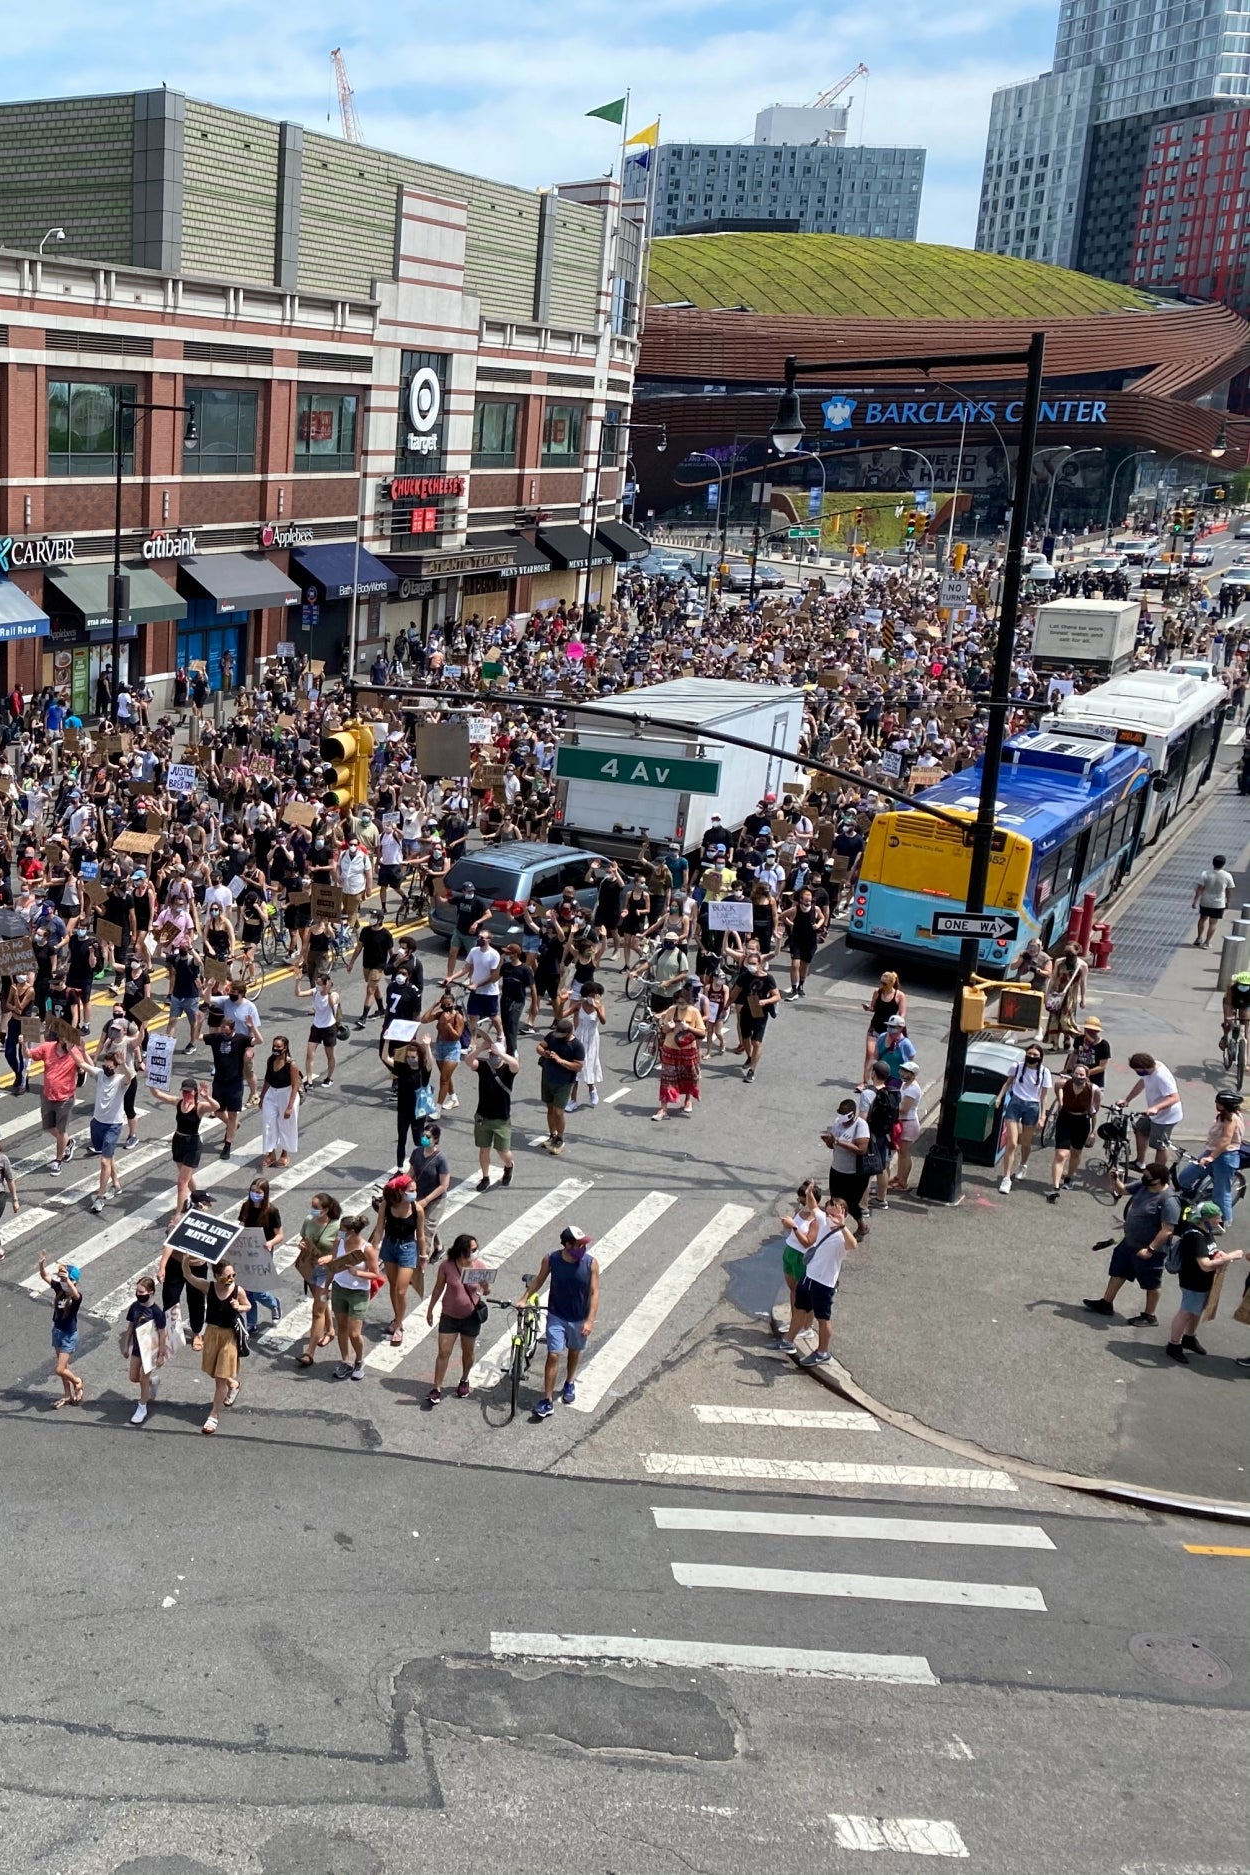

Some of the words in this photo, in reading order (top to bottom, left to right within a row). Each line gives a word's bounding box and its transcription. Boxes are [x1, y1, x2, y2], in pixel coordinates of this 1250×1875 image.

[865, 401, 996, 424] BARCLAYS
[1005, 401, 1108, 425] CNTER
[407, 432, 438, 455] target
[950, 454, 977, 466] GO
[919, 467, 976, 482] HARD
[391, 479, 421, 501] CHUCK
[428, 477, 466, 497] CHEESE'S
[11, 538, 77, 565] CARVER
[143, 531, 197, 559] citibank
[428, 558, 471, 573] ATLANTIC
[500, 568, 518, 577] MEN'S
[519, 562, 551, 576] WEARHOUSE
[568, 560, 584, 568] MEN'S
[339, 585, 353, 595] Bath
[410, 580, 433, 597] target
[947, 583, 962, 592] NO
[942, 594, 966, 602] TURNS
[17, 624, 37, 636] Road
[1094, 727, 1116, 737] 4599
[885, 752, 900, 763] NOW
[170, 766, 195, 777] JUSTICE
[600, 758, 620, 778] 4
[630, 761, 671, 784] Av
[711, 904, 736, 913] BLACK
[944, 920, 969, 931] ONE
[980, 921, 1006, 934] WAY
[12, 941, 24, 949] NO
[389, 992, 402, 1014] 7
[184, 1216, 210, 1232] BLACK
[209, 1223, 234, 1239] LIVES
[185, 1228, 218, 1246] MATTER
